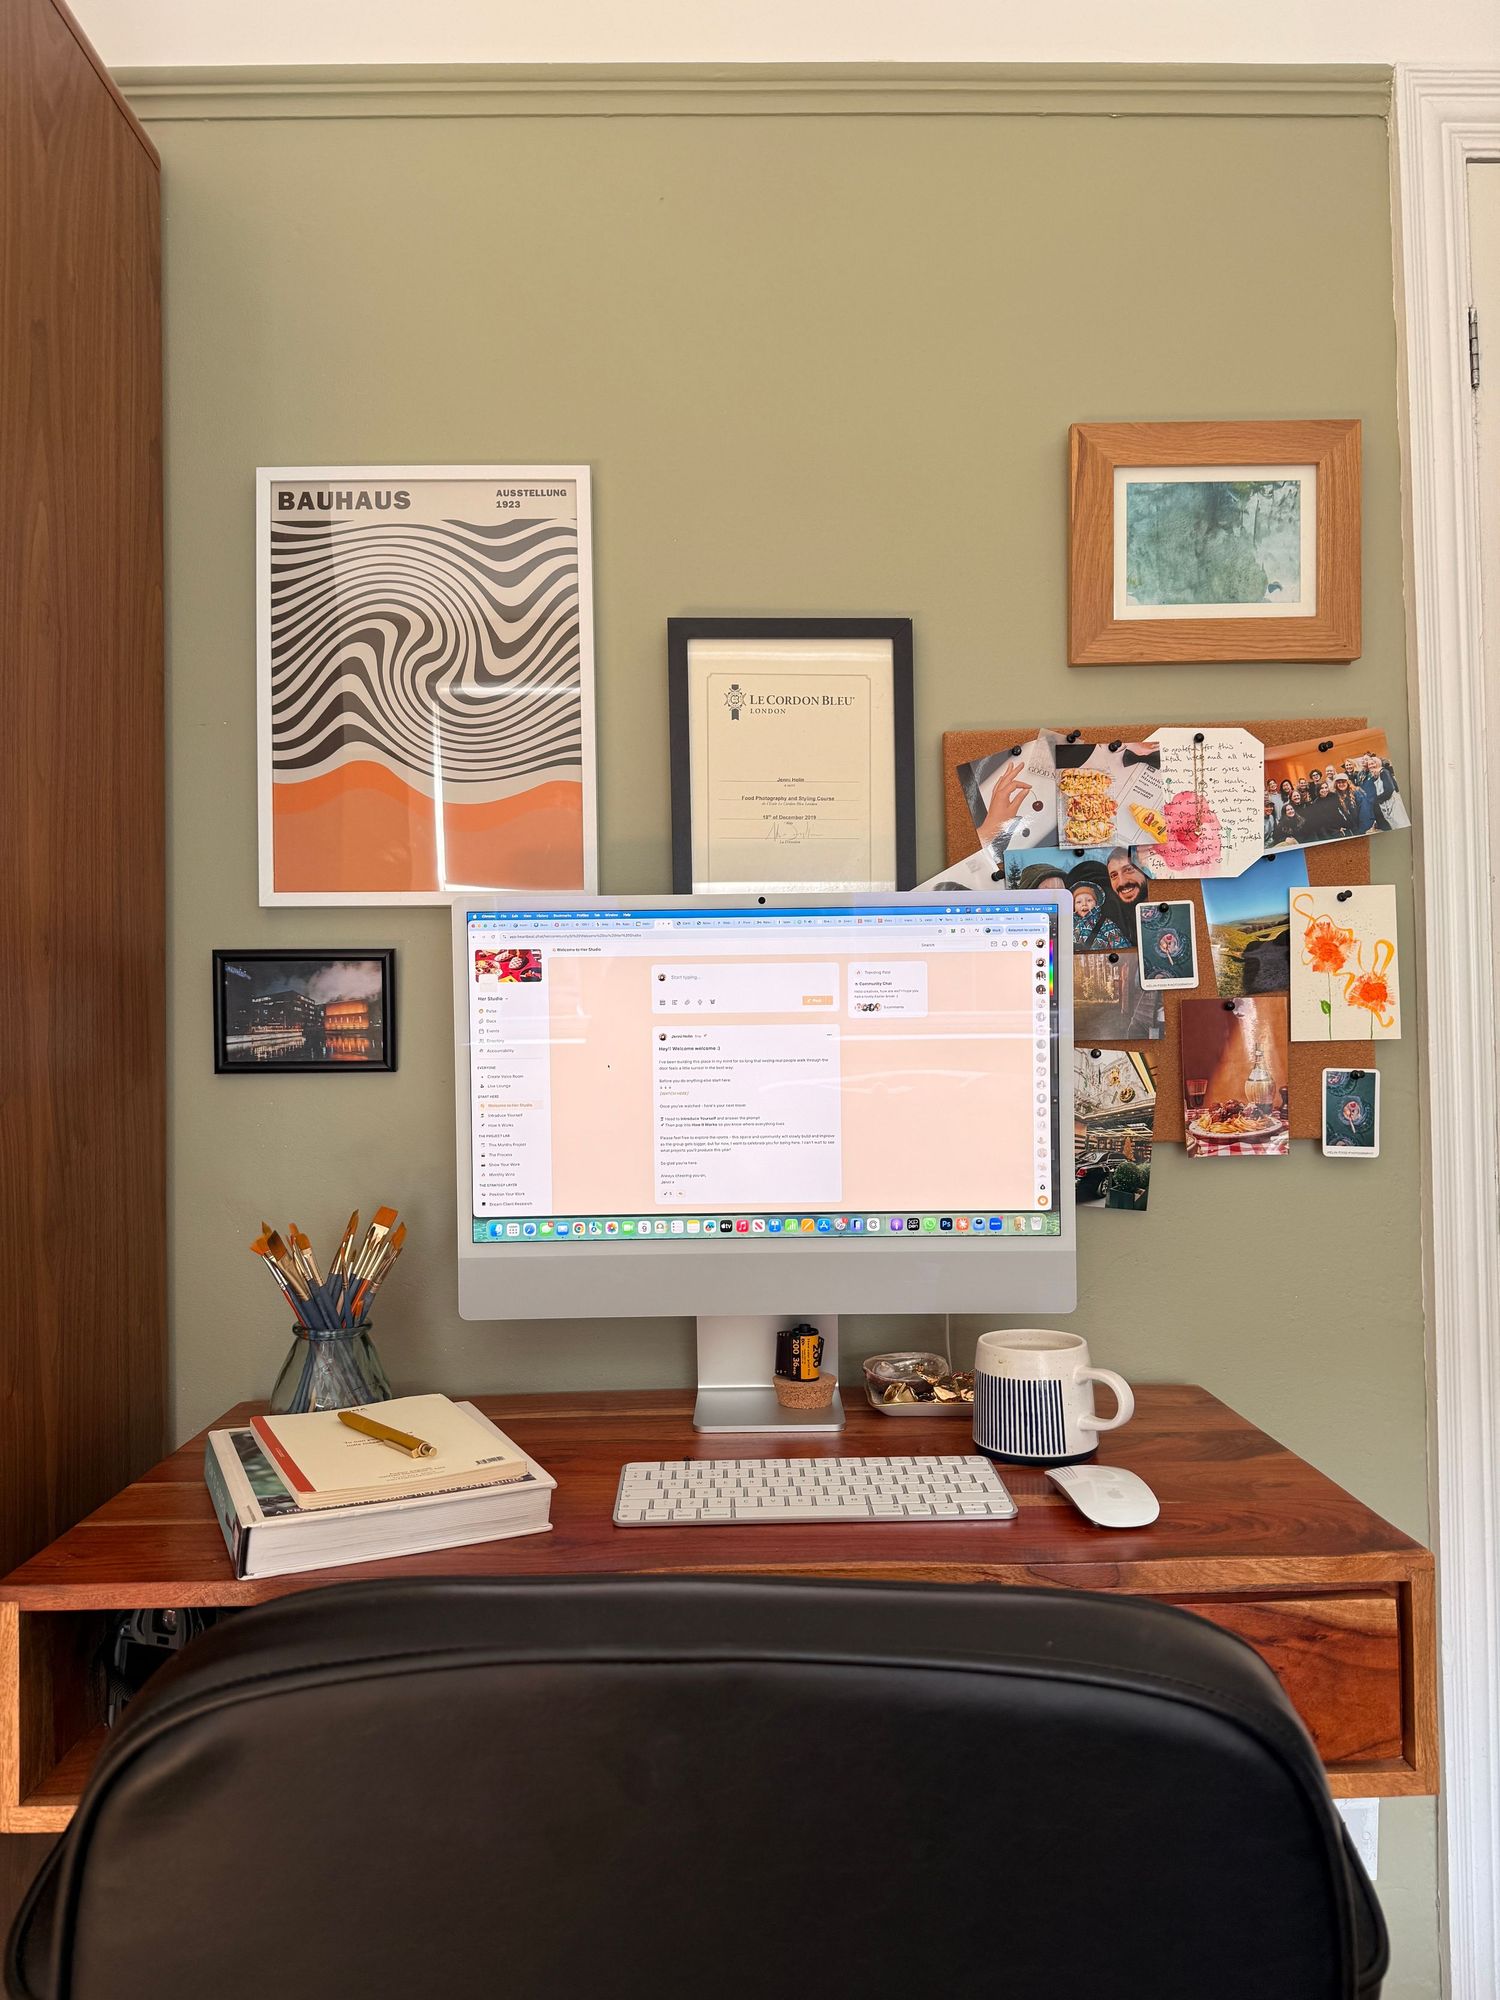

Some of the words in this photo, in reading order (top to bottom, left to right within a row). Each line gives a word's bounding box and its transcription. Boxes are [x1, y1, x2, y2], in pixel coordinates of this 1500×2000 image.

[496, 488, 567, 498] AUSSTELLUNG
[278, 490, 411, 511] BAUHAUS
[496, 500, 521, 508] 1923
[750, 695, 764, 705] LE
[766, 695, 819, 706] CORDON
